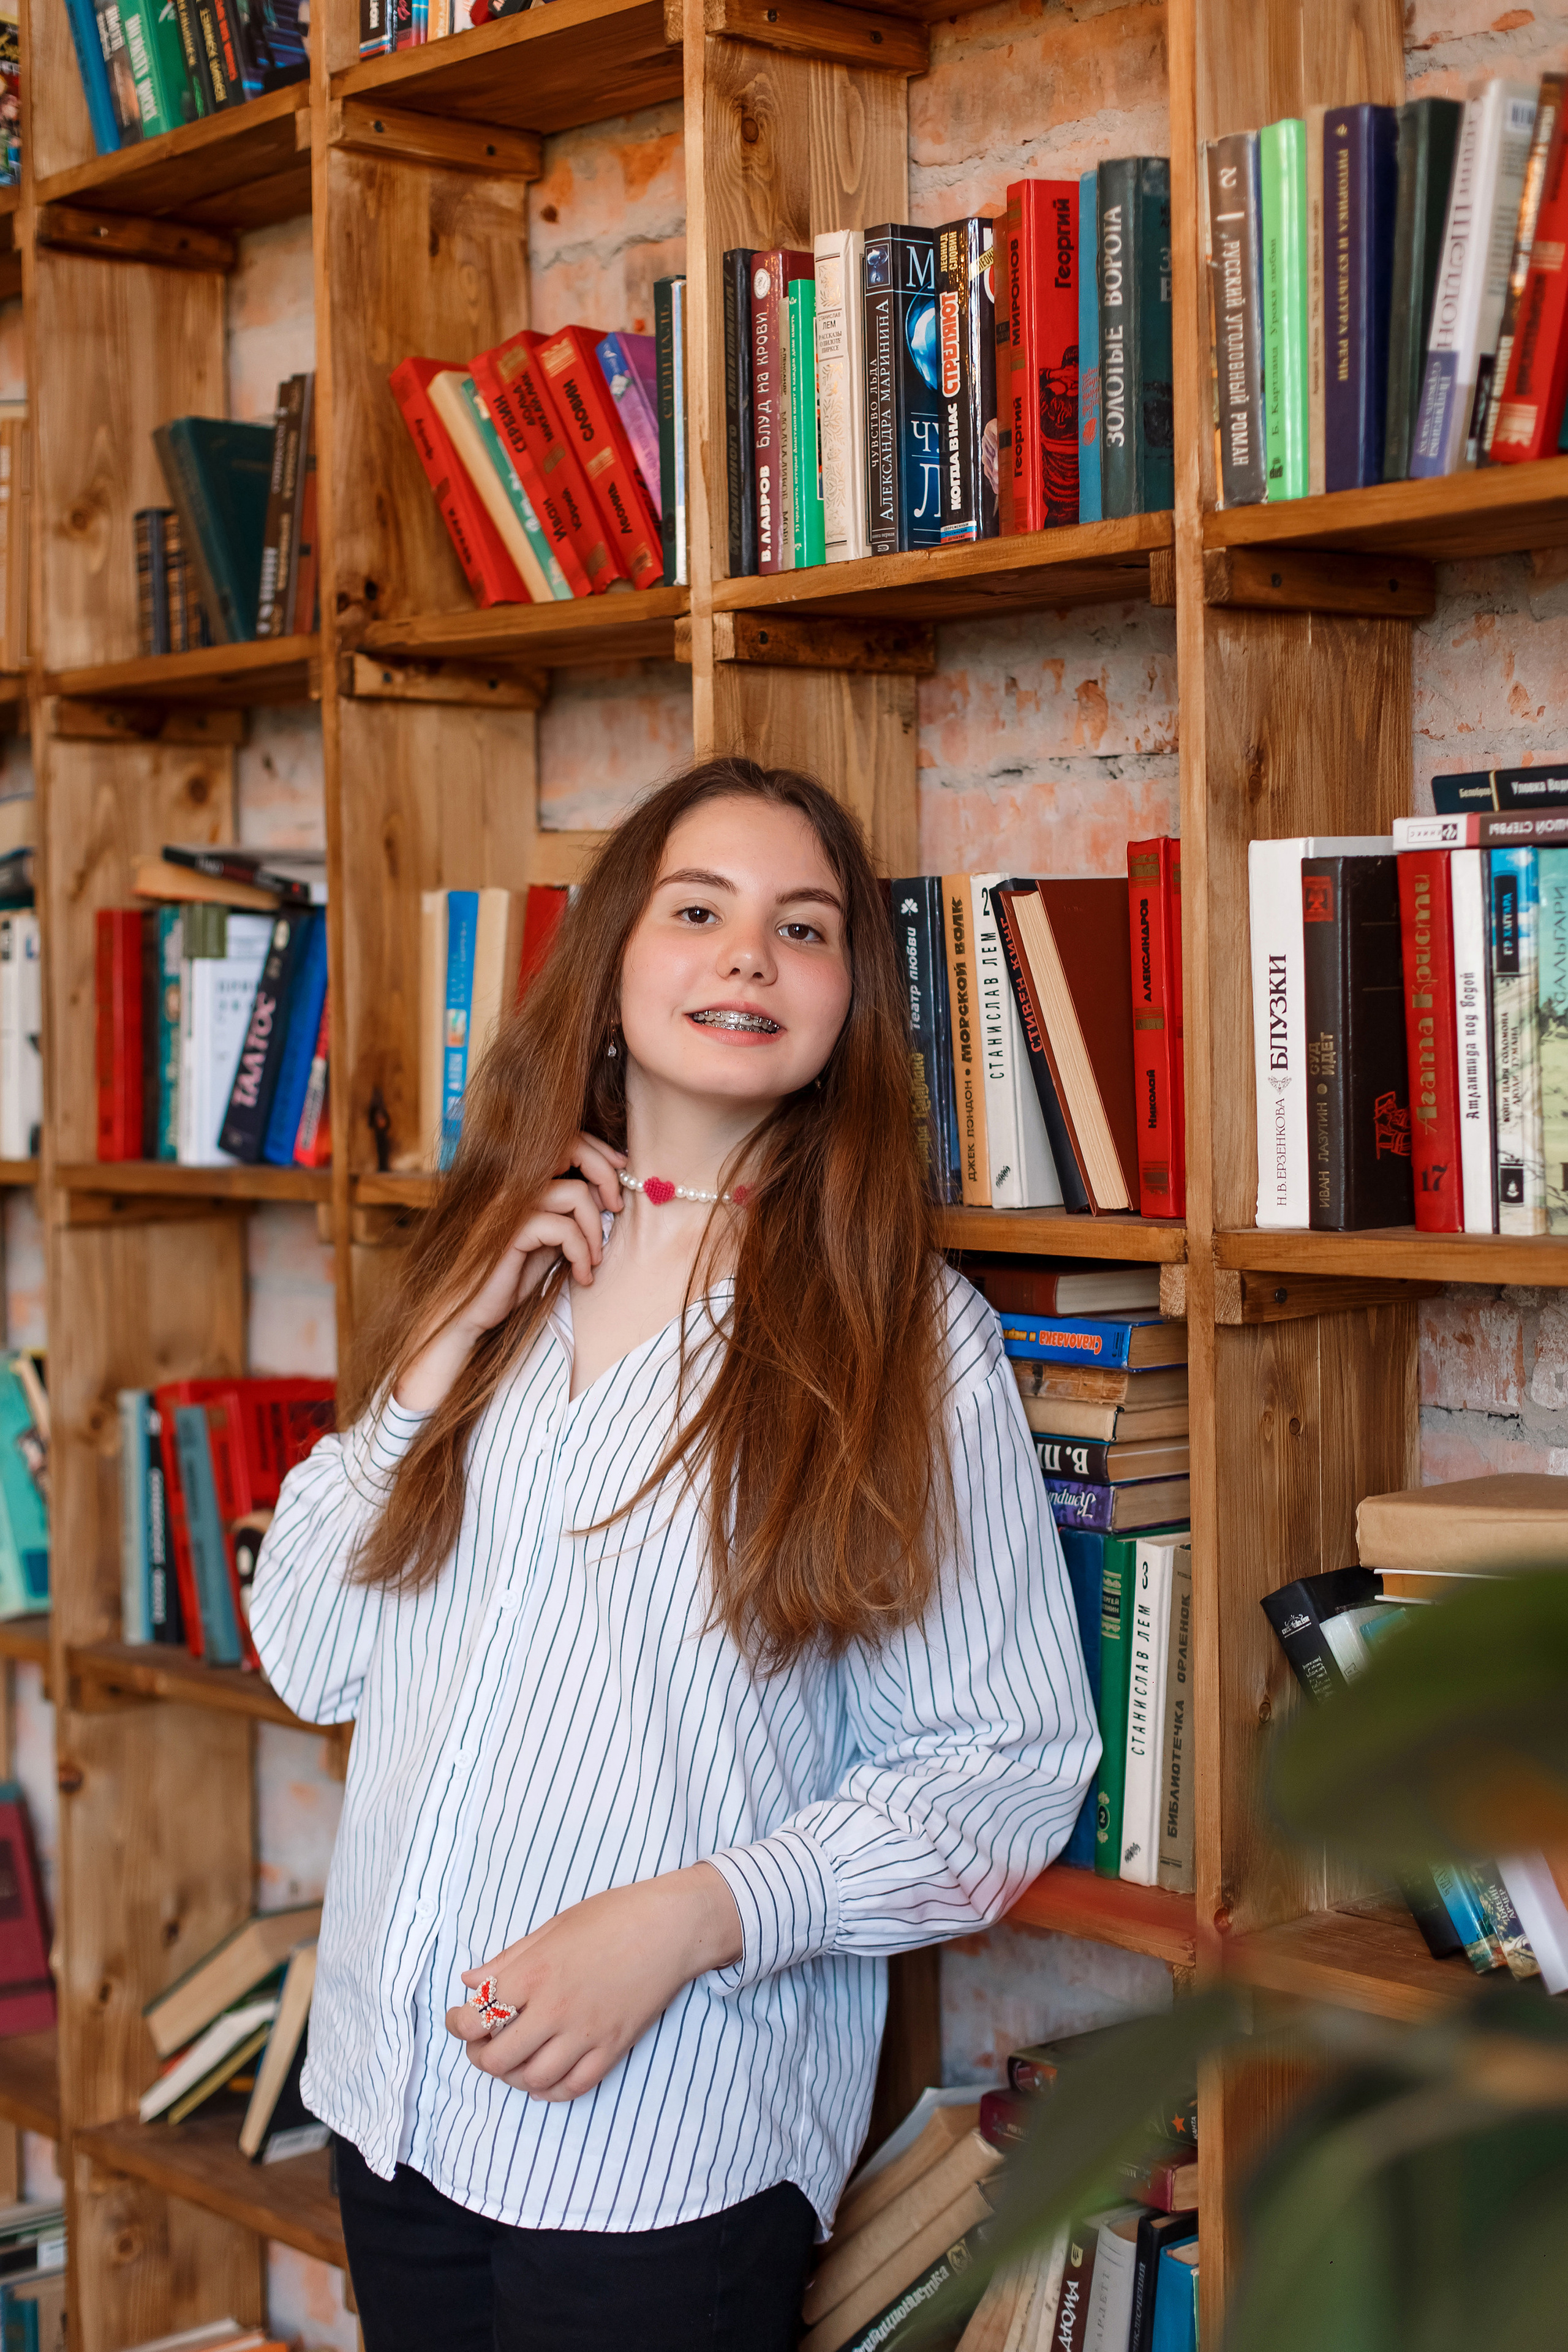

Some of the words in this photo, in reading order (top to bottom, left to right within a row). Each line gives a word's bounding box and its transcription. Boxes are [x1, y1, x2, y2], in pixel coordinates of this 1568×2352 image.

[1336, 149, 1348, 233] РИТОРИКА
[939, 232, 949, 273] ЛЕОНИД
[947, 230, 959, 271] СЛОВИН
[1052, 197, 1075, 289] Георгий
[1102, 204, 1123, 307] ВОРОТА
[1268, 238, 1278, 284] любви
[1336, 238, 1348, 249] И
[1009, 238, 1022, 346] МИРОНОВ
[1223, 239, 1248, 309] РУССКИЙ
[1336, 253, 1349, 335] КУЛЬТУРА
[1436, 203, 1472, 349] Шелдон
[818, 312, 842, 322] СТАНИСЛАВ
[818, 331, 842, 342] РАССКАЗЫ
[822, 319, 836, 330] ЛЕМ
[1269, 289, 1280, 336] Уроки
[877, 298, 892, 402] МАРИНИНА
[940, 291, 960, 398] СТРЕЛЯЮТ
[1226, 312, 1250, 406] УГОЛОВНЫЙ
[1336, 339, 1348, 382] РЕЧИ
[870, 358, 879, 395] ЛЬДА
[1104, 325, 1125, 448] ЗОЛОТЫЕ
[1270, 346, 1280, 415] Картланд
[493, 395, 527, 454] СЕРБИН
[563, 379, 595, 442] СЛОВИН
[756, 398, 773, 450] БЛУД
[870, 401, 880, 468] ЧУВСТВО
[946, 402, 959, 439] НАС
[1012, 396, 1025, 478] Георгий
[1231, 409, 1250, 467] РОМАН
[1270, 420, 1281, 437] Б.
[880, 409, 895, 522] АЛЕКСАНДРА
[948, 440, 959, 450] В
[607, 481, 633, 535] Леонид
[949, 451, 962, 510] КОГДА
[542, 497, 567, 543] Иван
[562, 487, 583, 533] Юрий
[1488, 820, 1533, 835] СТЕРВЫ
[951, 895, 967, 956] ВОЛК
[981, 886, 990, 916] 2
[907, 926, 918, 981] любви
[981, 932, 998, 967] ЛЕМ
[1000, 918, 1022, 973] КИНГ
[1139, 898, 1153, 1003] АЛЕКСАНДРОВ
[1411, 873, 1438, 1009] Кристи
[908, 986, 922, 1030] Театр
[956, 962, 973, 1063] МОРСКОЙ
[1013, 975, 1044, 1053] СТИВЕН
[1270, 953, 1287, 1072] БЛУЗКИ
[1460, 971, 1476, 1002] водой
[984, 975, 1005, 1080] СТАНИСЛАВ
[1464, 1008, 1479, 1032] под
[1501, 1012, 1510, 1063] СОЛОМОНА
[1511, 1025, 1520, 1067] ТУМАНА
[1308, 1042, 1320, 1076] СУД
[1319, 1031, 1336, 1076] ИДЕТ
[1412, 1017, 1438, 1137] Агата
[1466, 1038, 1480, 1120] Атлантида
[965, 1079, 977, 1142] ЛОНДОН
[1147, 1069, 1157, 1129] Николай
[1317, 1102, 1329, 1163] ЛАЗУТИН
[968, 1144, 978, 1182] ДЖЕК
[1318, 1170, 1330, 1208] ИВАН
[1420, 1165, 1448, 1193] 17
[1038, 1328, 1103, 1355] Скалолазка
[1061, 1447, 1090, 1474] В.
[1048, 1479, 1099, 1520] Кэтри
[1142, 1561, 1150, 1589] 3
[1137, 1604, 1151, 1642] ЛЕМ
[1131, 1649, 1148, 1757] СТАНИСЛАВ
[1166, 1700, 1185, 1839] БИБЛИОТЕЧКА
[1176, 1593, 1191, 1685] ОРЛЕНОК
[1057, 2280, 1080, 2352] ДЮМА
